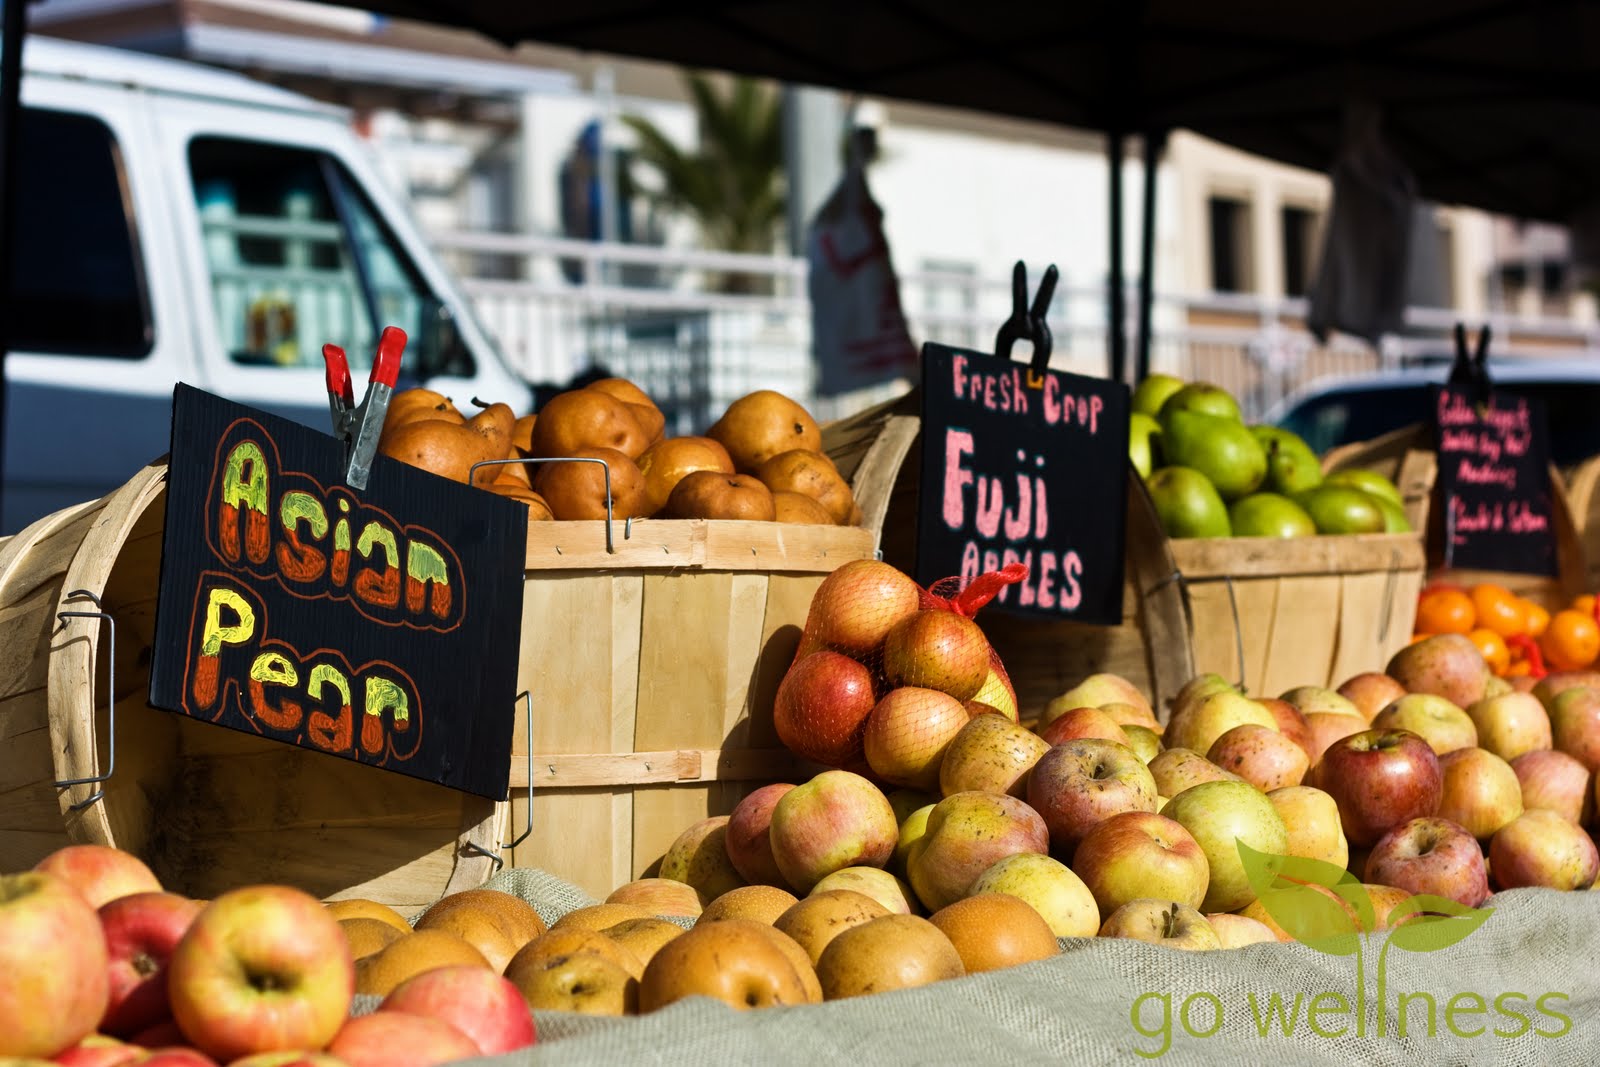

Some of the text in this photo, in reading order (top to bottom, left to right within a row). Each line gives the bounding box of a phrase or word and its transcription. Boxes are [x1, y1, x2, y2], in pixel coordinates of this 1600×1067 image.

[219, 439, 453, 619] Asian
[942, 428, 1049, 541] Fuji
[193, 587, 409, 753] Pear
